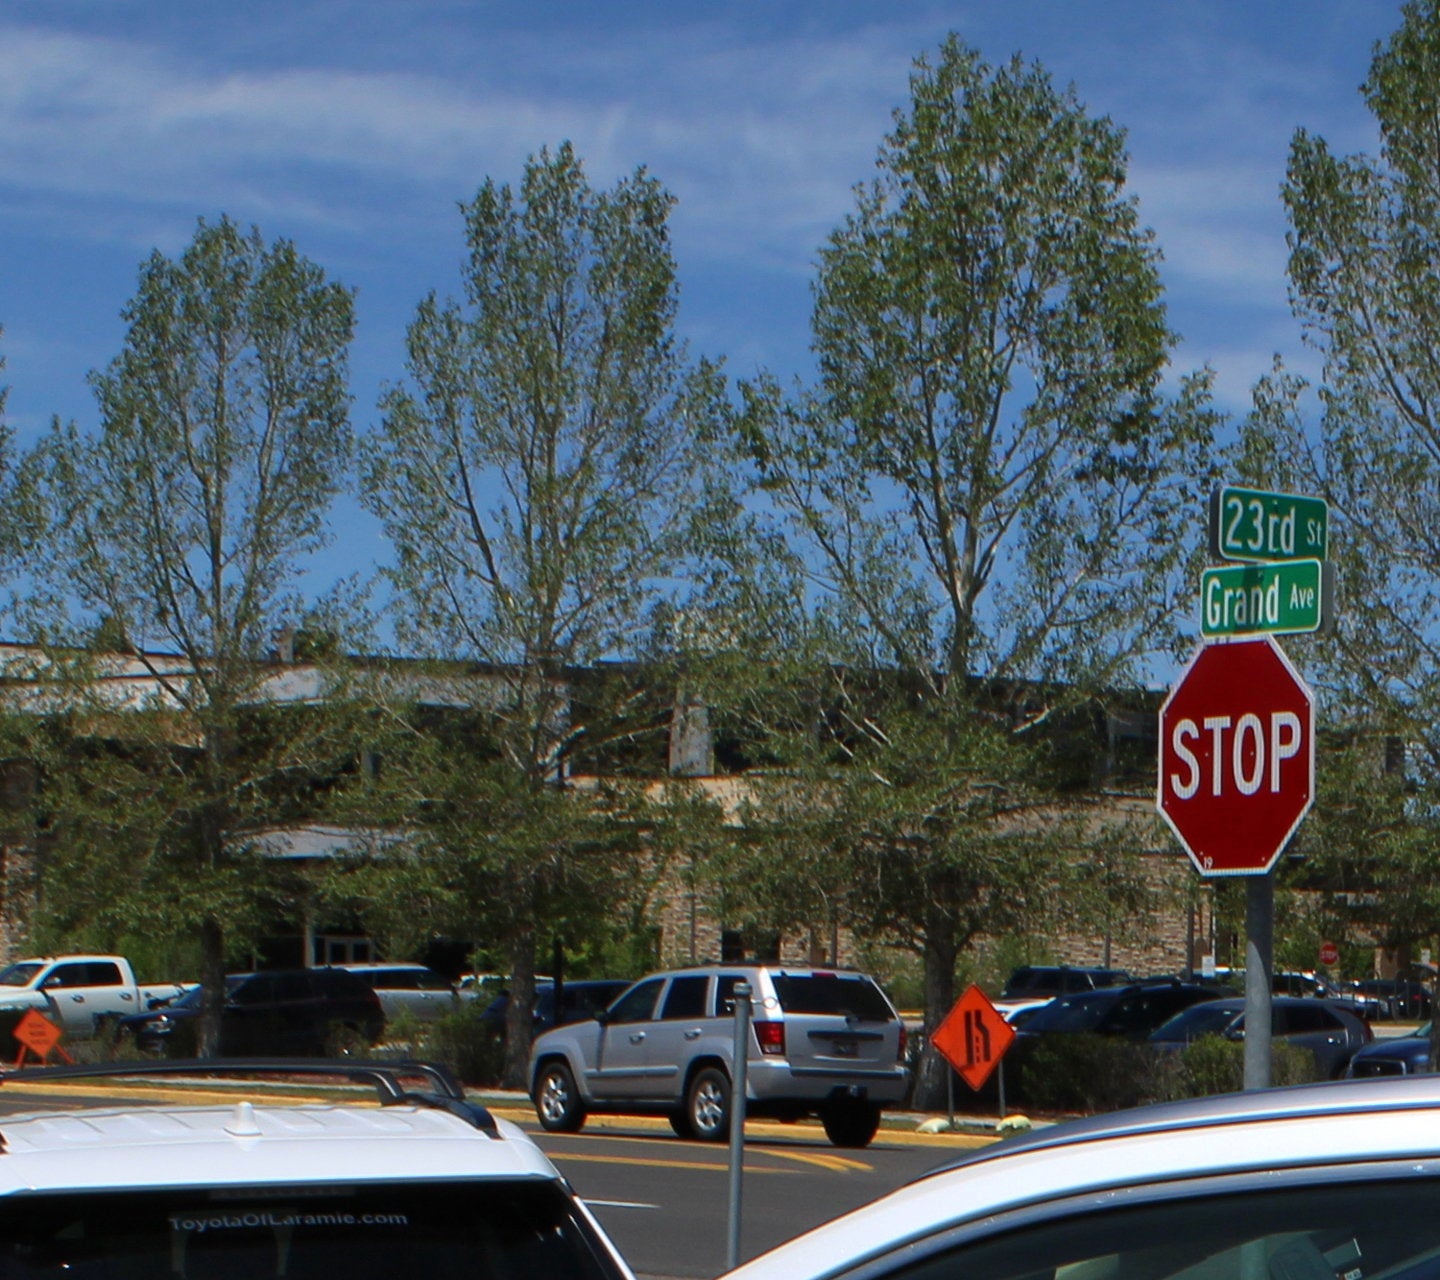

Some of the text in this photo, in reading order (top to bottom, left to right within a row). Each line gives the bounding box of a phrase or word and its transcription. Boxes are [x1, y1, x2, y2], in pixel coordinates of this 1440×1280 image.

[1225, 497, 1322, 555] 23rd St
[1206, 574, 1315, 629] Grand Ave
[1170, 711, 1302, 800] STOP
[1203, 856, 1213, 869] 19
[168, 1212, 408, 1232] ToyotaOfLaramie.com
